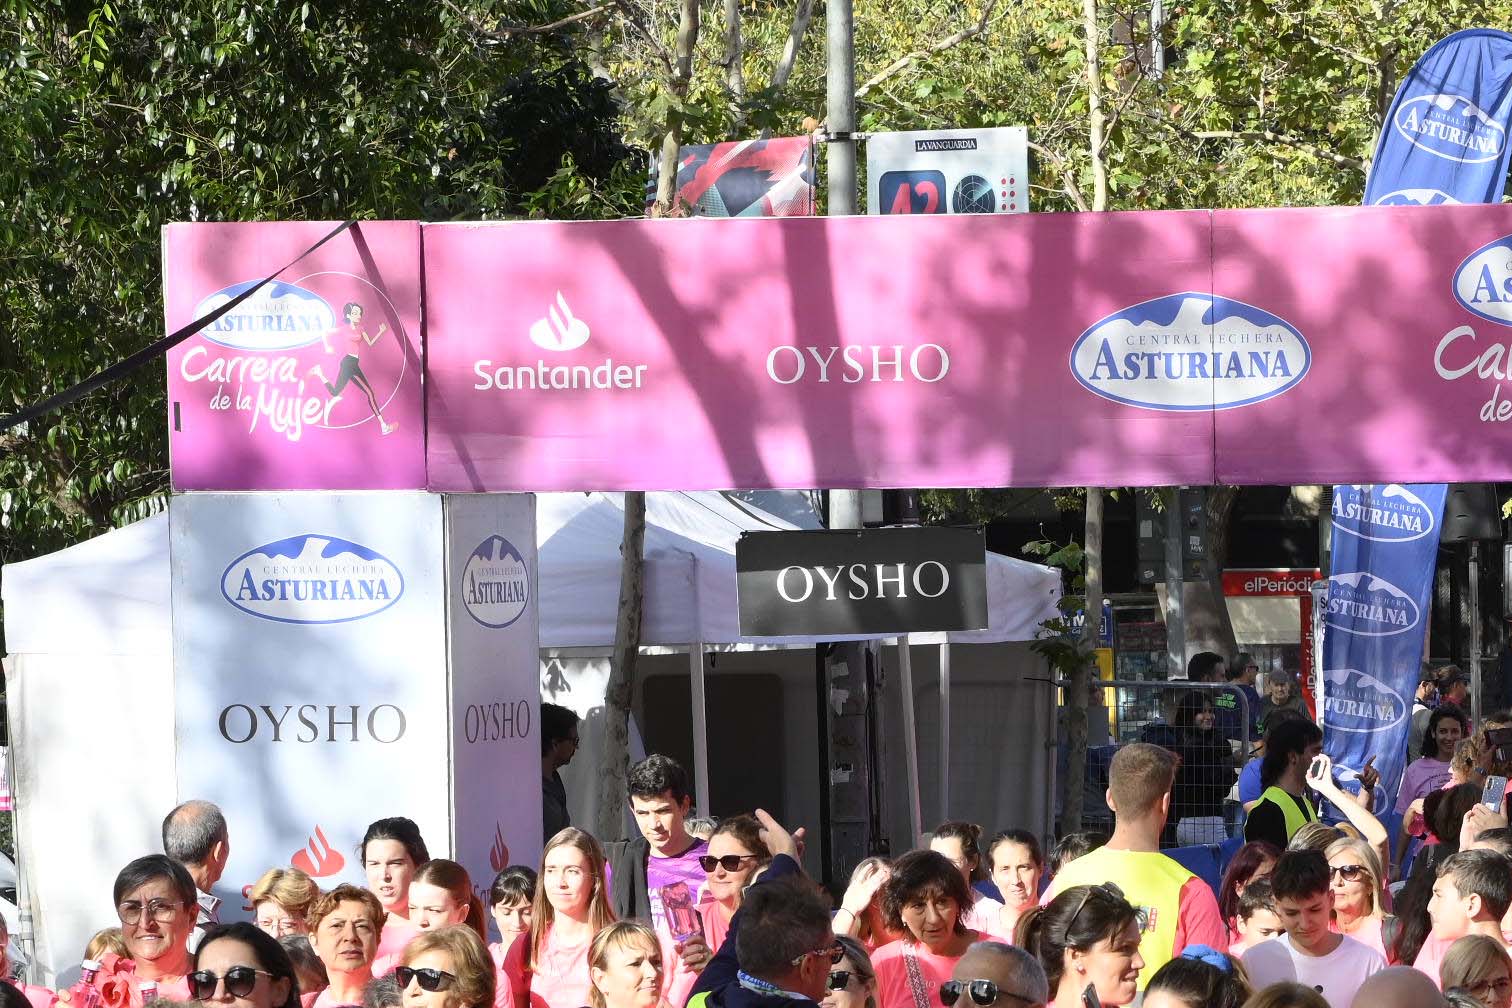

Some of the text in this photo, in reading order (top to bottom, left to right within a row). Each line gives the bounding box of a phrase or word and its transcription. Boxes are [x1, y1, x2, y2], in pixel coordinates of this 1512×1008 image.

[1402, 106, 1498, 154] ASTURIANA
[206, 312, 325, 333] ASTURIANA
[1126, 330, 1285, 347] CENTRAL LECHERA
[180, 346, 299, 383] Carrera
[474, 359, 648, 392] Santander
[766, 342, 950, 385] OYSHO
[1089, 337, 1293, 382] ASTURIANA
[210, 381, 343, 442] de la Mujer
[1332, 492, 1423, 533] ASTURIANA
[235, 567, 392, 602] ASTURIANA
[262, 564, 319, 575] CENTRAL
[467, 569, 525, 605] ASTURIANA
[777, 560, 950, 603] OYSHO
[1326, 598, 1409, 627] STURIANA
[218, 703, 407, 744] OYSHO
[464, 700, 531, 744] OYSHO
